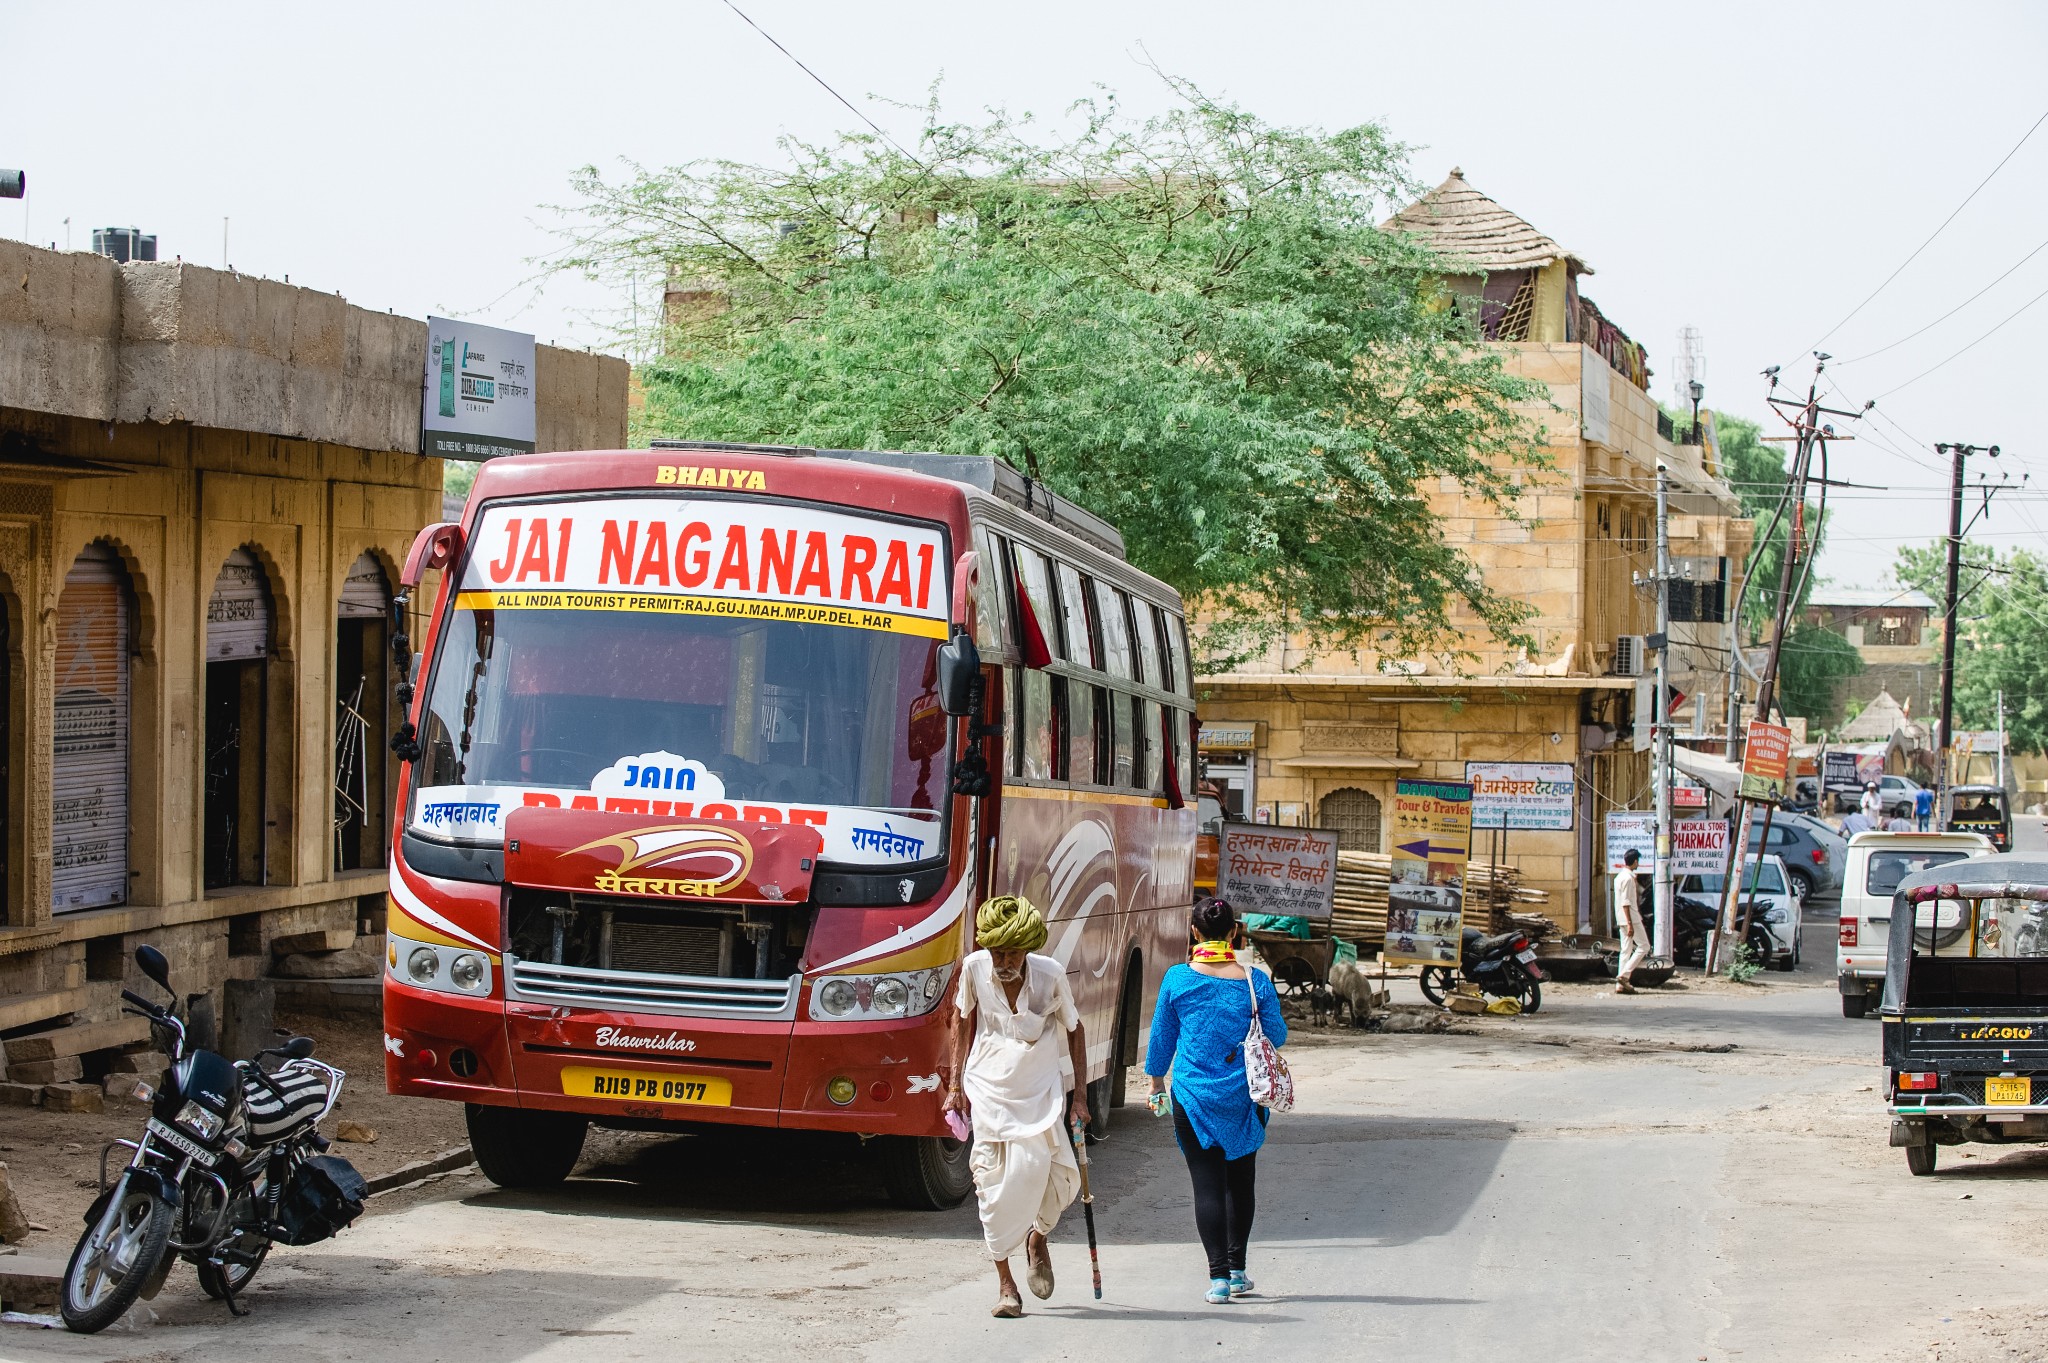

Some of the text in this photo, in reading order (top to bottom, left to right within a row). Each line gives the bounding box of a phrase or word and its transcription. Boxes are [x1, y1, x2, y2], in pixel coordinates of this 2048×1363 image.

[465, 351, 486, 362] LAFARGE
[461, 378, 495, 399] DURAGUARD
[466, 402, 489, 413] CEMENT
[656, 465, 766, 490] BHAIYA
[489, 517, 935, 610] JAI NAGANARAI
[497, 595, 521, 607] ALL
[525, 595, 562, 607] INDIA
[566, 595, 625, 608] TOURIST
[862, 614, 892, 629] HAR
[1749, 728, 1765, 737] REAL
[1751, 738, 1765, 747] MAN
[1755, 749, 1778, 760] SAFARI
[1398, 783, 1470, 800] BARIYAM
[422, 802, 501, 828] अहमदाबाद
[1396, 799, 1420, 812] Tour
[1422, 800, 1431, 812] &
[1433, 801, 1470, 815] Travles
[1680, 822, 1706, 832] MEDICAL
[1708, 822, 1727, 831] STORE
[851, 822, 924, 861] रामदेवरा
[1227, 832, 1267, 853] हसन
[1267, 835, 1300, 853] खान
[1682, 850, 1695, 858] TYPE
[1698, 850, 1725, 858] RECHARGE
[1677, 860, 1719, 869] ARE AVAILABLE
[595, 868, 723, 897] सेतरावा
[593, 1076, 707, 1101] RJ19 PB 0977
